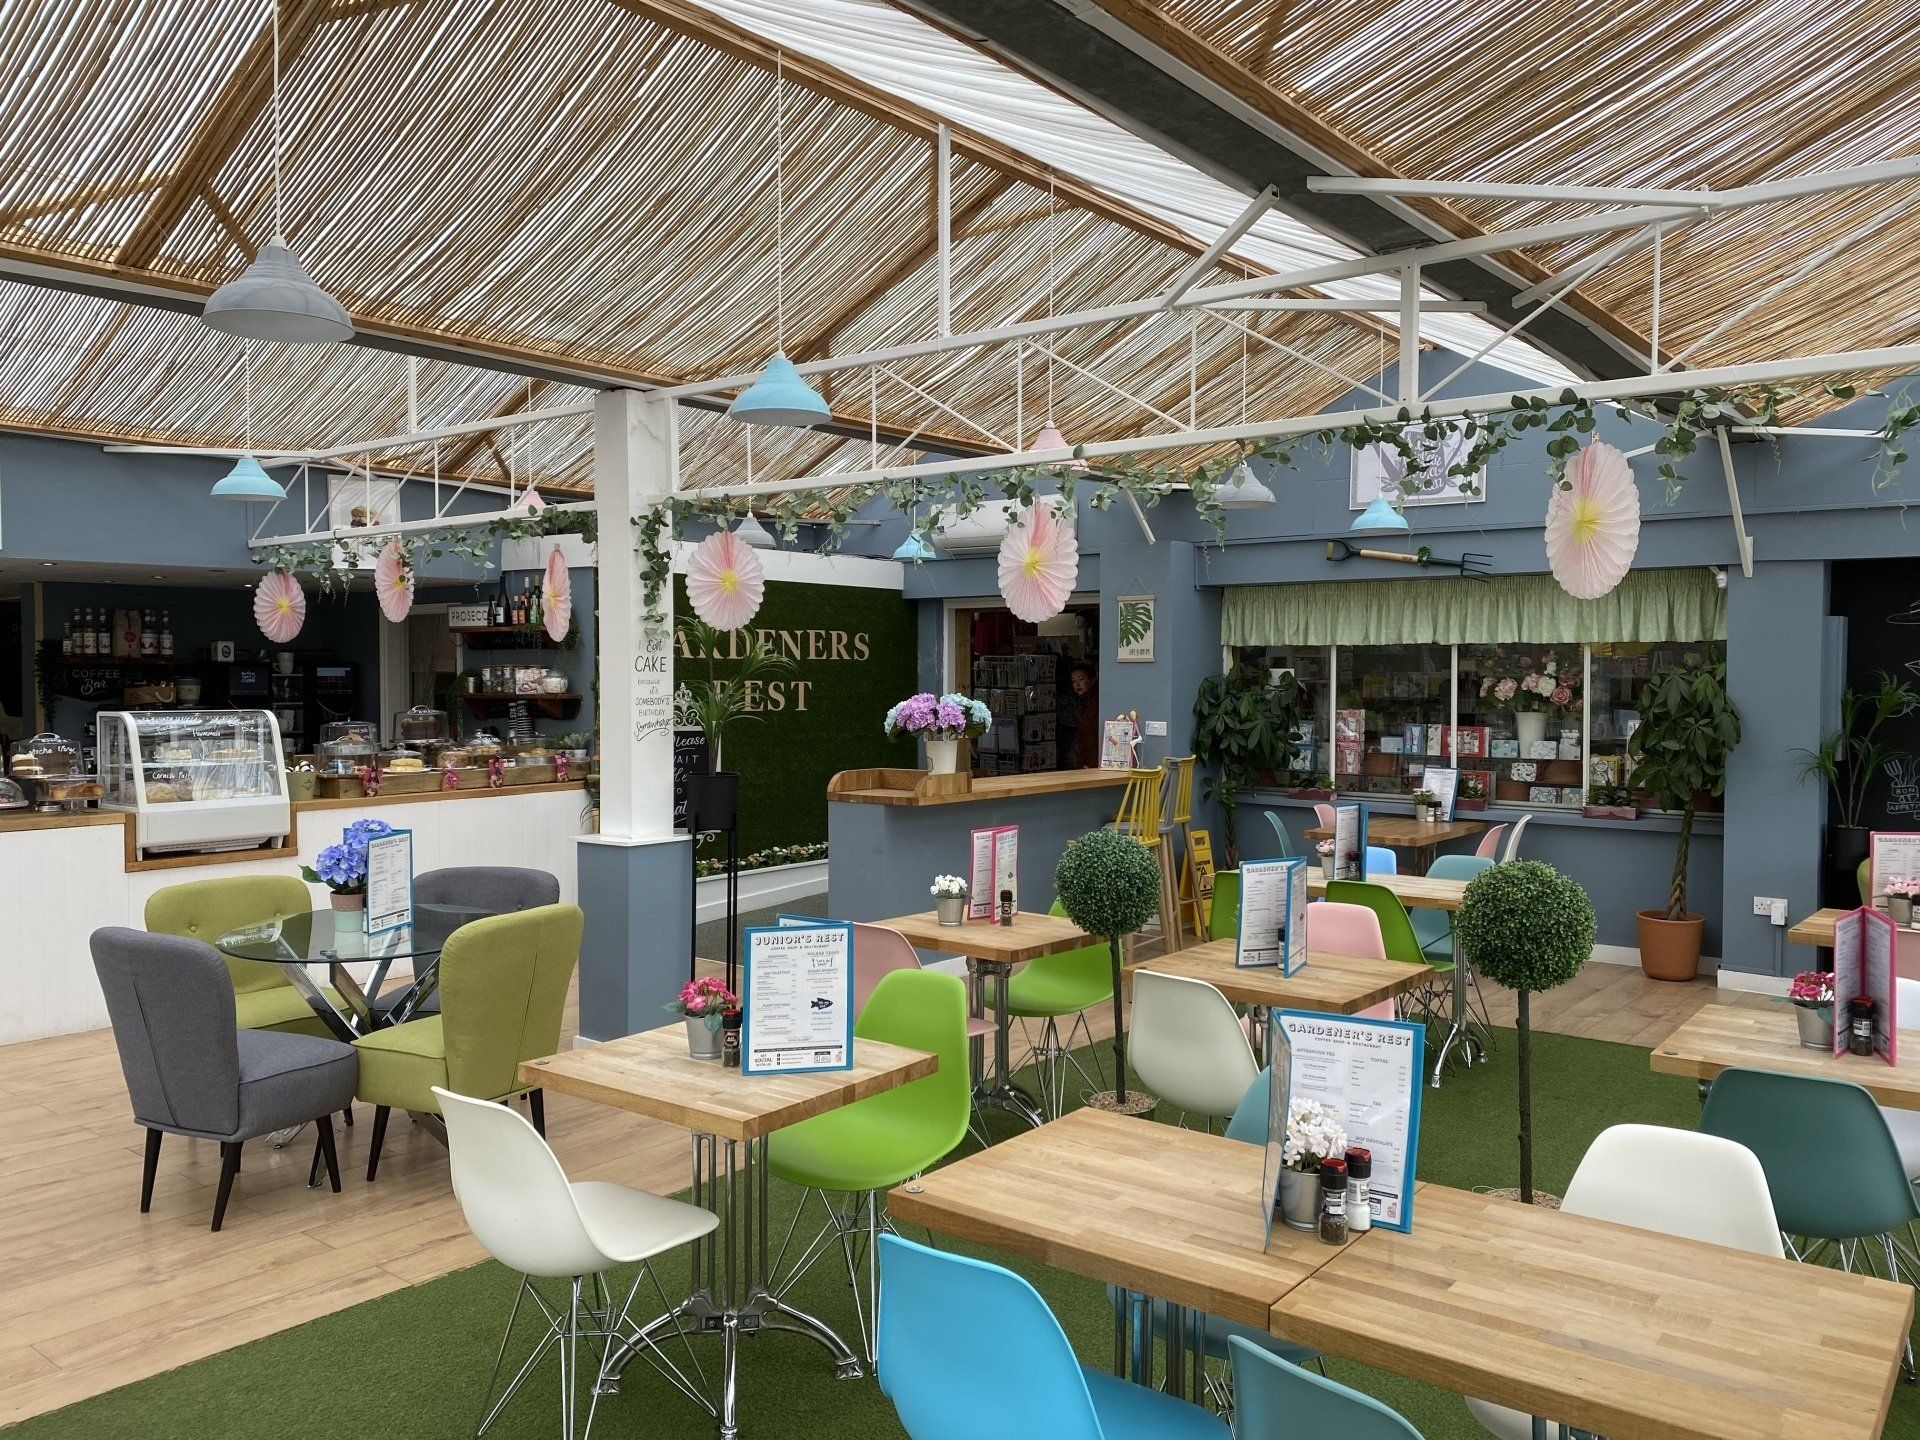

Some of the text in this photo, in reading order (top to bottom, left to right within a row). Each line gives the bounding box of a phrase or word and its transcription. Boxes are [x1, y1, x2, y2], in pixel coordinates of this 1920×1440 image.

[451, 610, 488, 621] PROSECC
[673, 626, 870, 660] ADENERS
[634, 656, 667, 673] CAKE
[71, 669, 121, 679] COFFEE
[80, 678, 108, 695] Bar
[635, 697, 670, 706] SOMEBODY'S
[638, 709, 666, 717] BIRTHDAY
[674, 755, 700, 764] AIT
[152, 772, 175, 780] Cornish
[755, 932, 845, 946] JUNIOR'S REST
[1288, 1023, 1411, 1047] GARDENER'S REST
